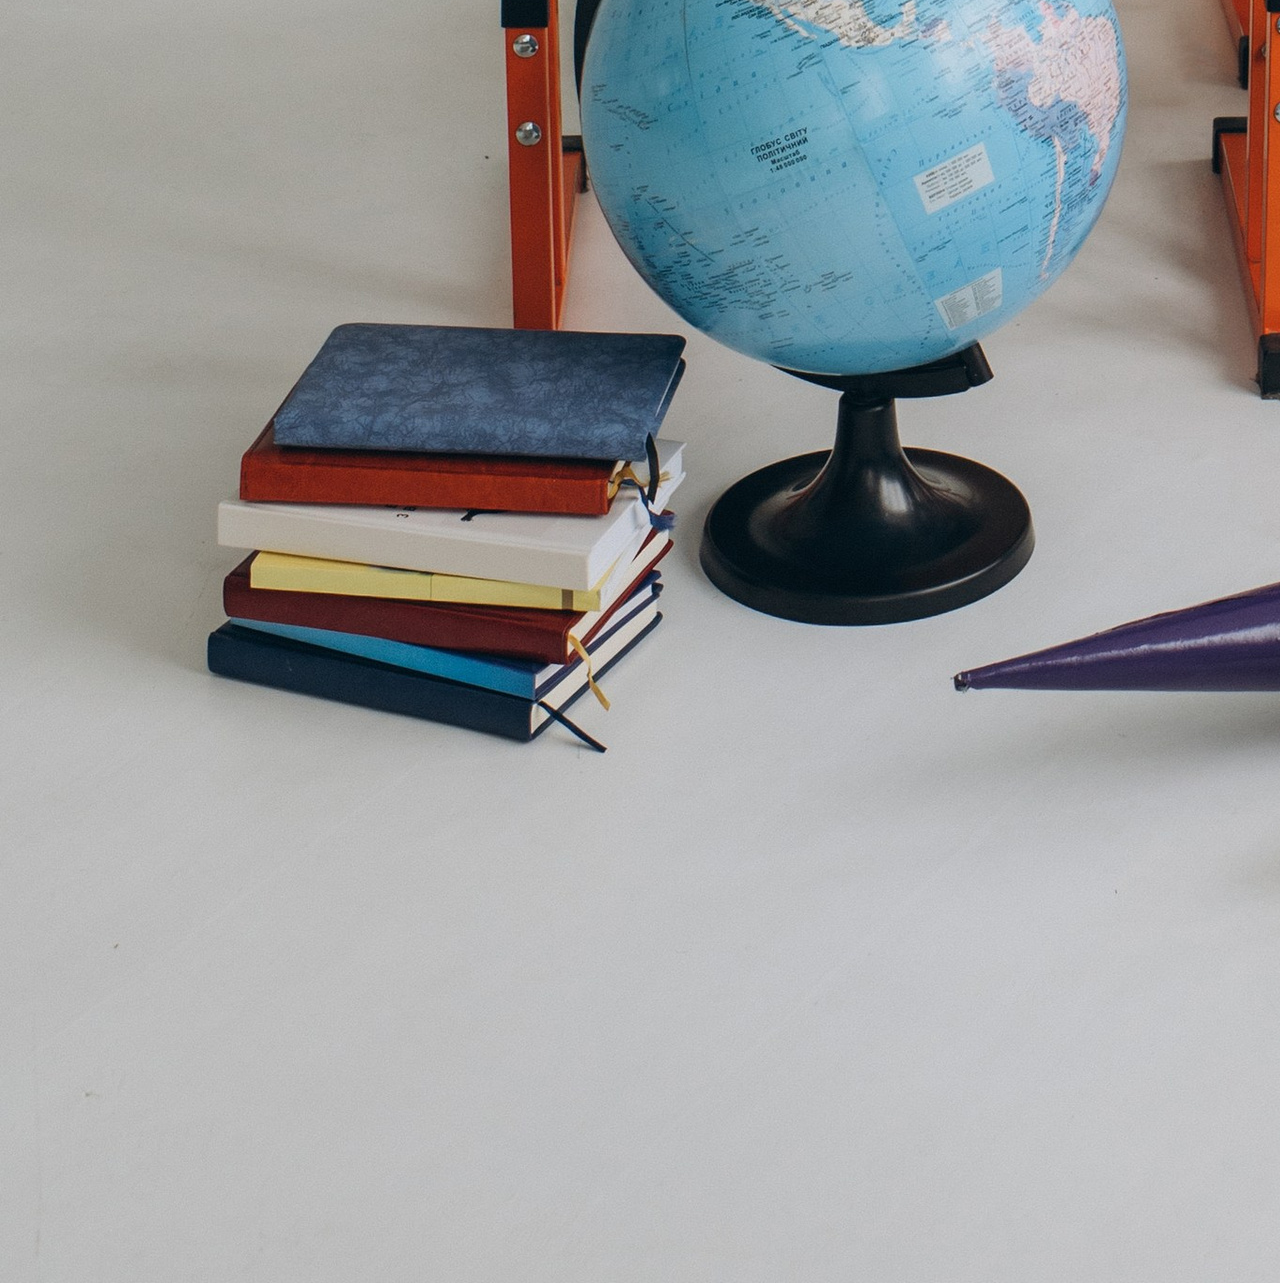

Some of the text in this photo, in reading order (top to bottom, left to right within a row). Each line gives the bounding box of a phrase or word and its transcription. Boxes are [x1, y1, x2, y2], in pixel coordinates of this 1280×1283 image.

[750, 126, 808, 155] ГЛОБУС СВІТУ
[756, 136, 809, 163] ПОЛІТИЧНИЙ
[770, 149, 801, 165] Масштаб
